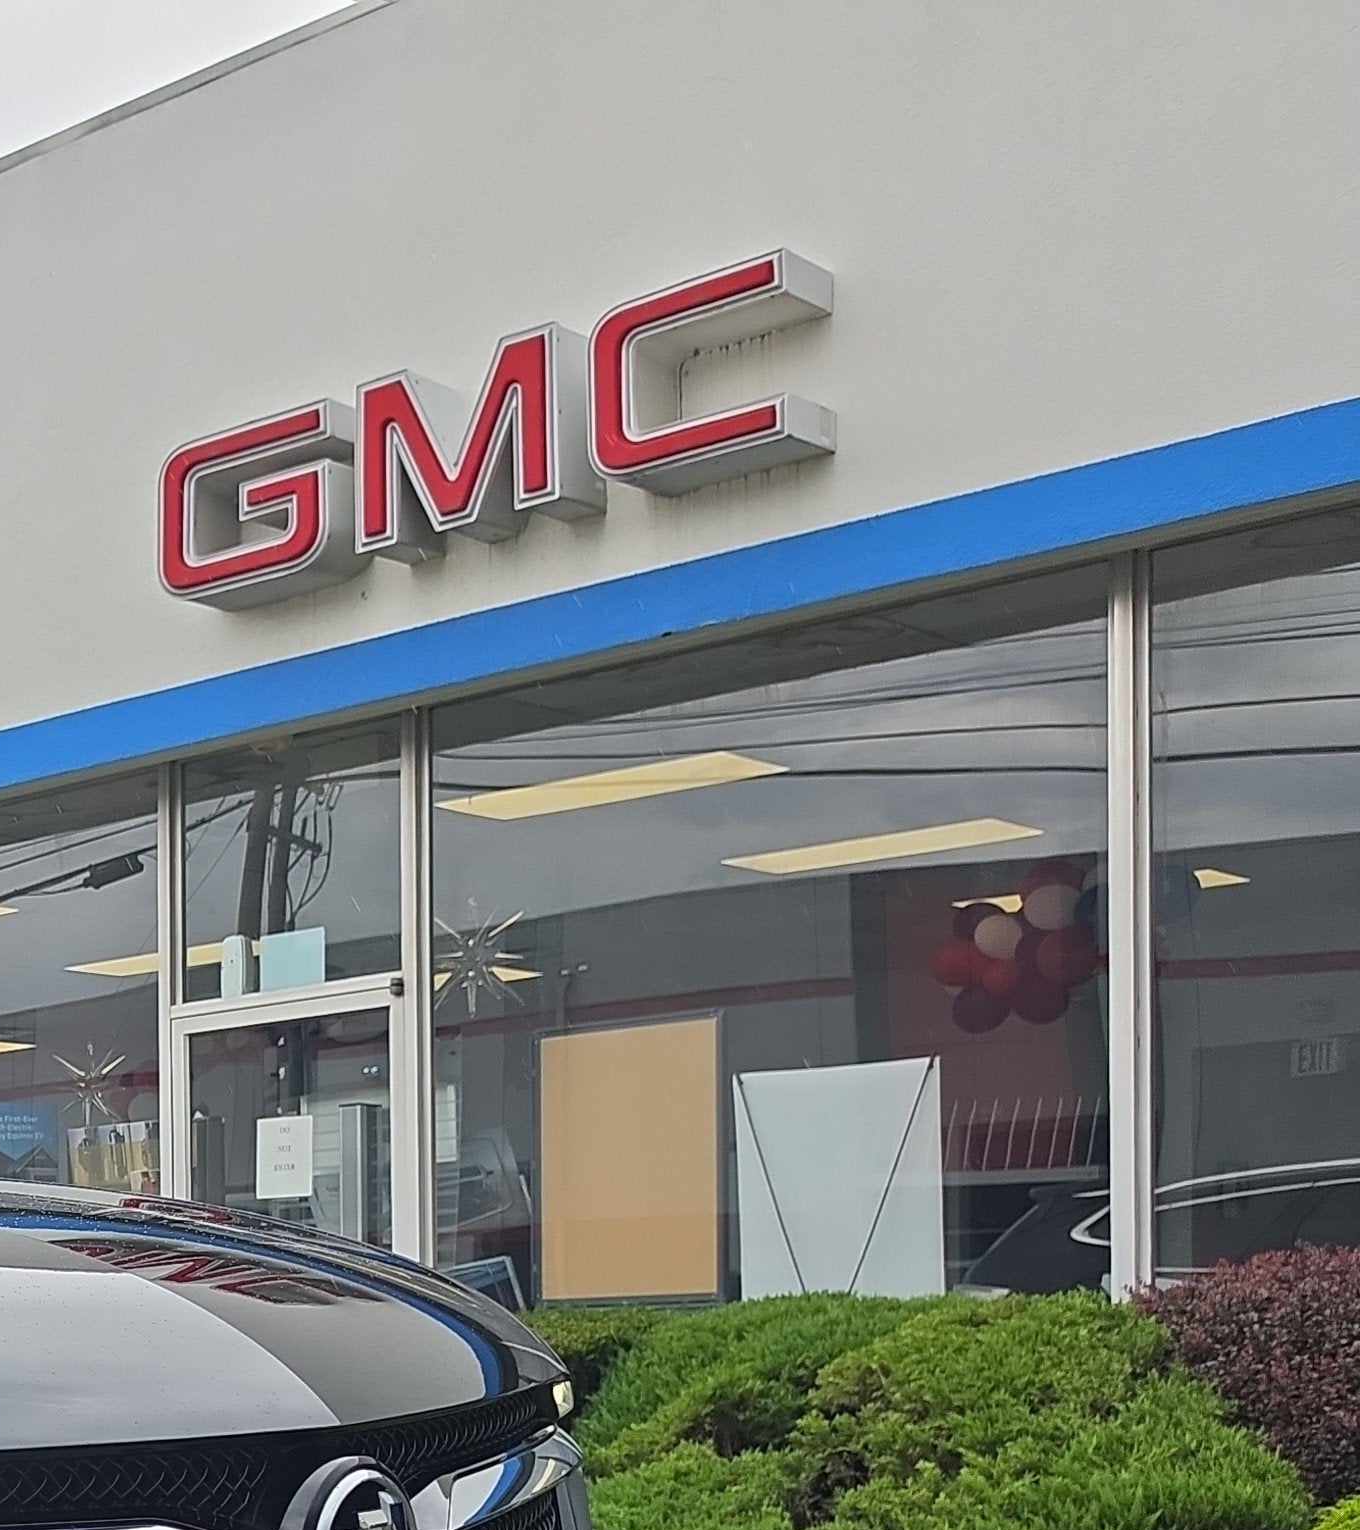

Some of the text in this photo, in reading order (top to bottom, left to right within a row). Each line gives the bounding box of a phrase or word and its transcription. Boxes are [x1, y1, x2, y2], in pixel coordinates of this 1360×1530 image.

[158, 247, 792, 600] GMC
[1298, 1042, 1335, 1073] EXIT
[4, 1115, 38, 1123] First-Ever
[277, 1145, 292, 1153] NOT
